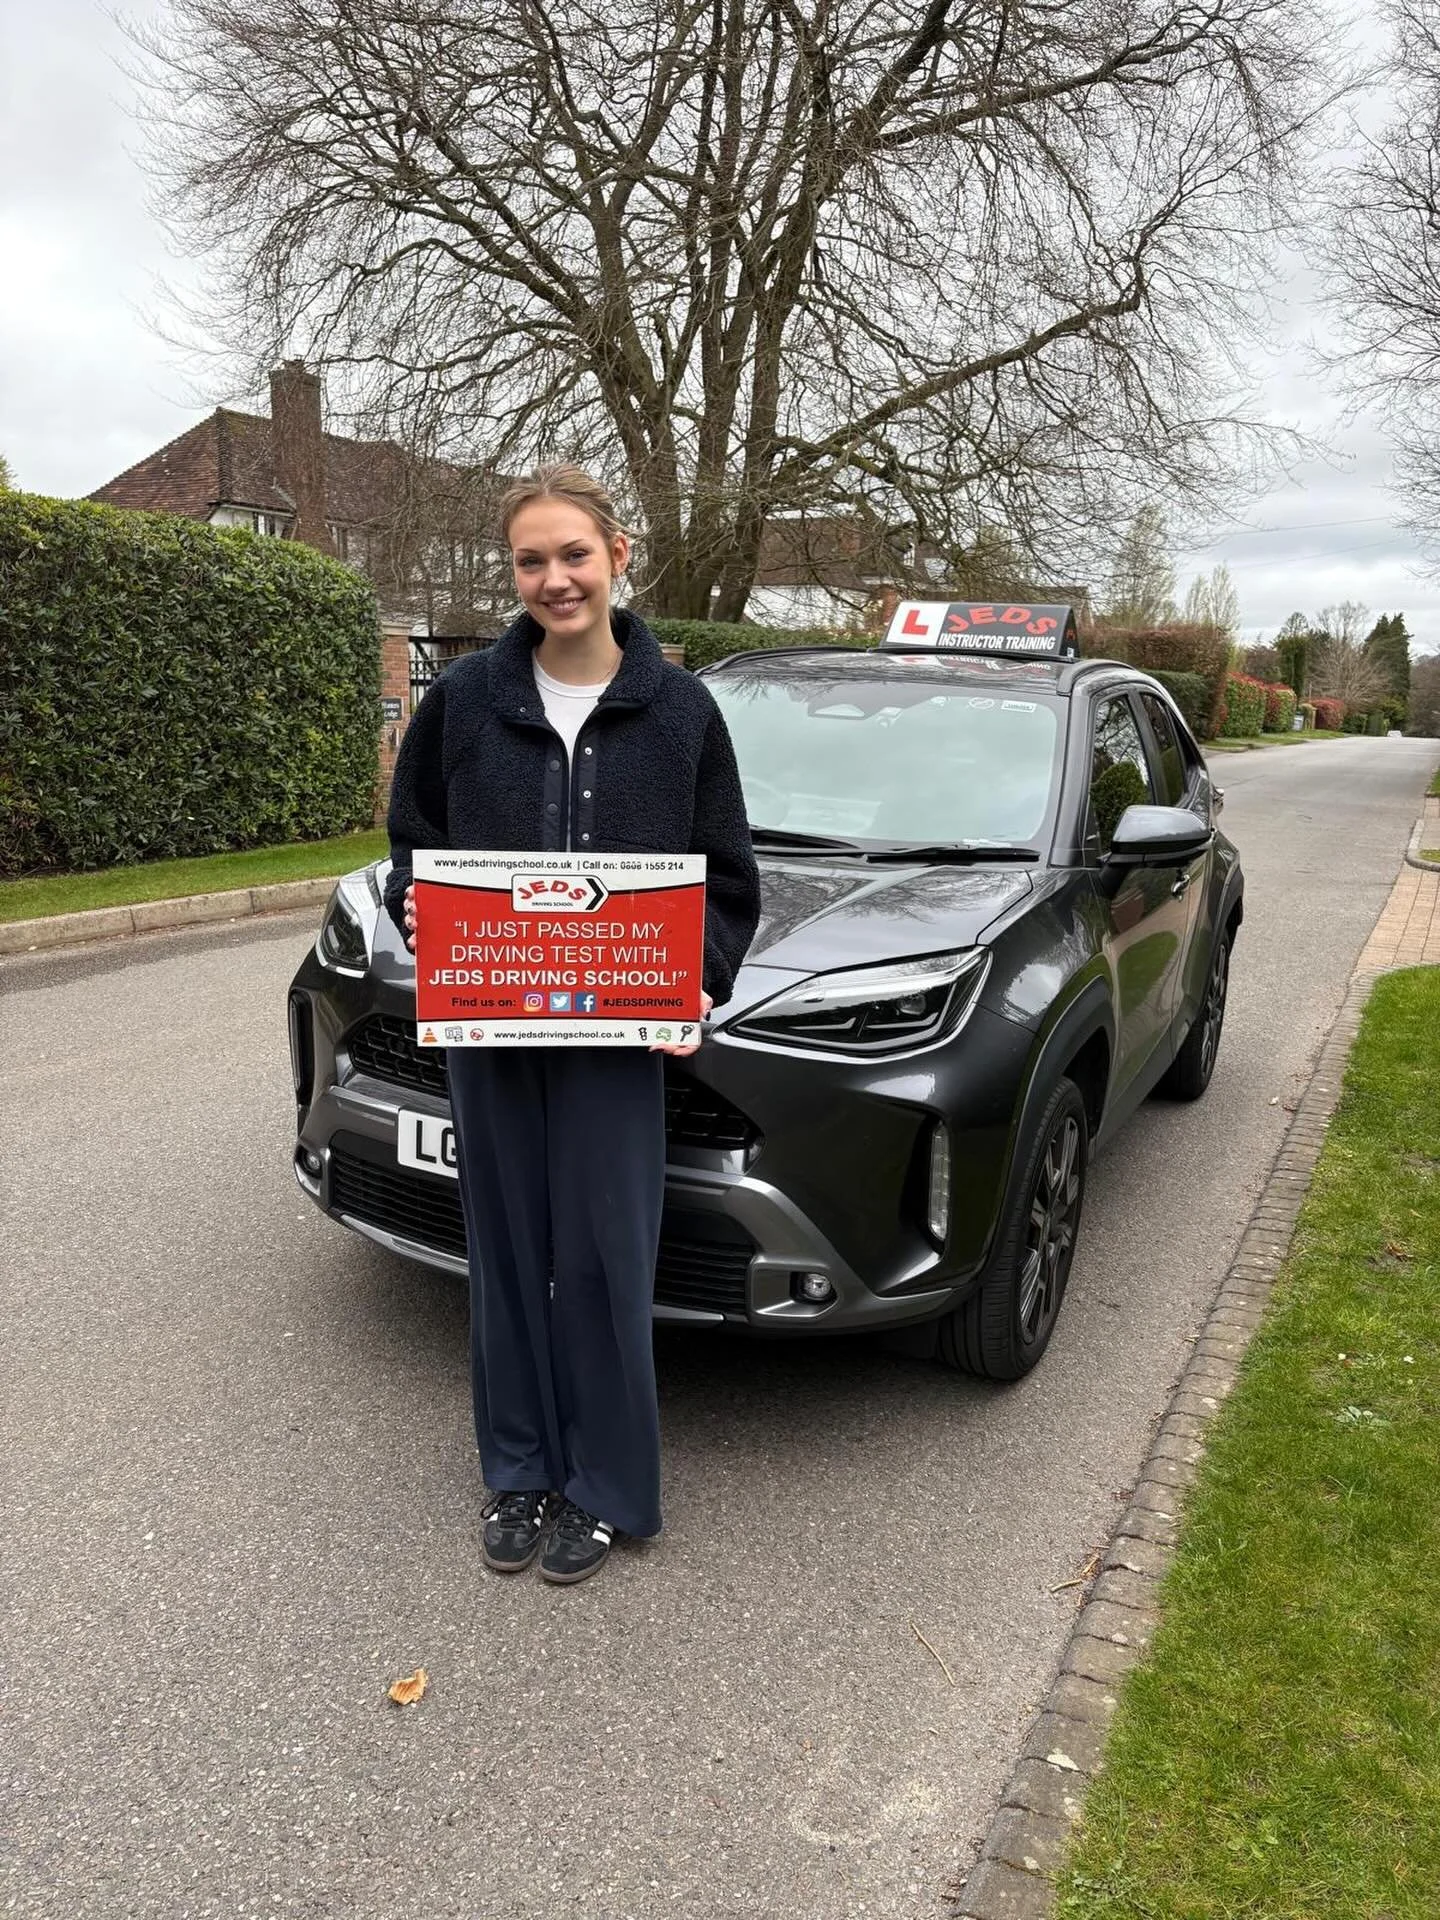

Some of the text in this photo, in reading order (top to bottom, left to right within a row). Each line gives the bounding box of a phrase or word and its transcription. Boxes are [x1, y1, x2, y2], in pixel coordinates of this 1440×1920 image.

[901, 610, 928, 634] L
[948, 606, 1057, 635] JEDS
[938, 632, 1056, 650] INSTRUCTOR TRAINING
[434, 858, 572, 869] www.jedsdrivingschool.co.uk
[582, 860, 601, 870] Call
[602, 862, 618, 870] on:
[667, 862, 684, 870] 214
[517, 880, 587, 900] JEDS
[475, 921, 531, 938] JUST
[537, 922, 625, 938] PASSED
[632, 923, 665, 939] MY
[451, 945, 667, 963] DRIVING TEST WITH
[429, 969, 484, 985] JEDS
[491, 970, 577, 986] DRIVING
[451, 997, 478, 1007] Find
[481, 999, 496, 1007] us
[498, 999, 516, 1007] on:
[602, 998, 684, 1008] #JEDSDRIVING
[494, 1031, 625, 1040] www.jedsdrivingschool.co.uk
